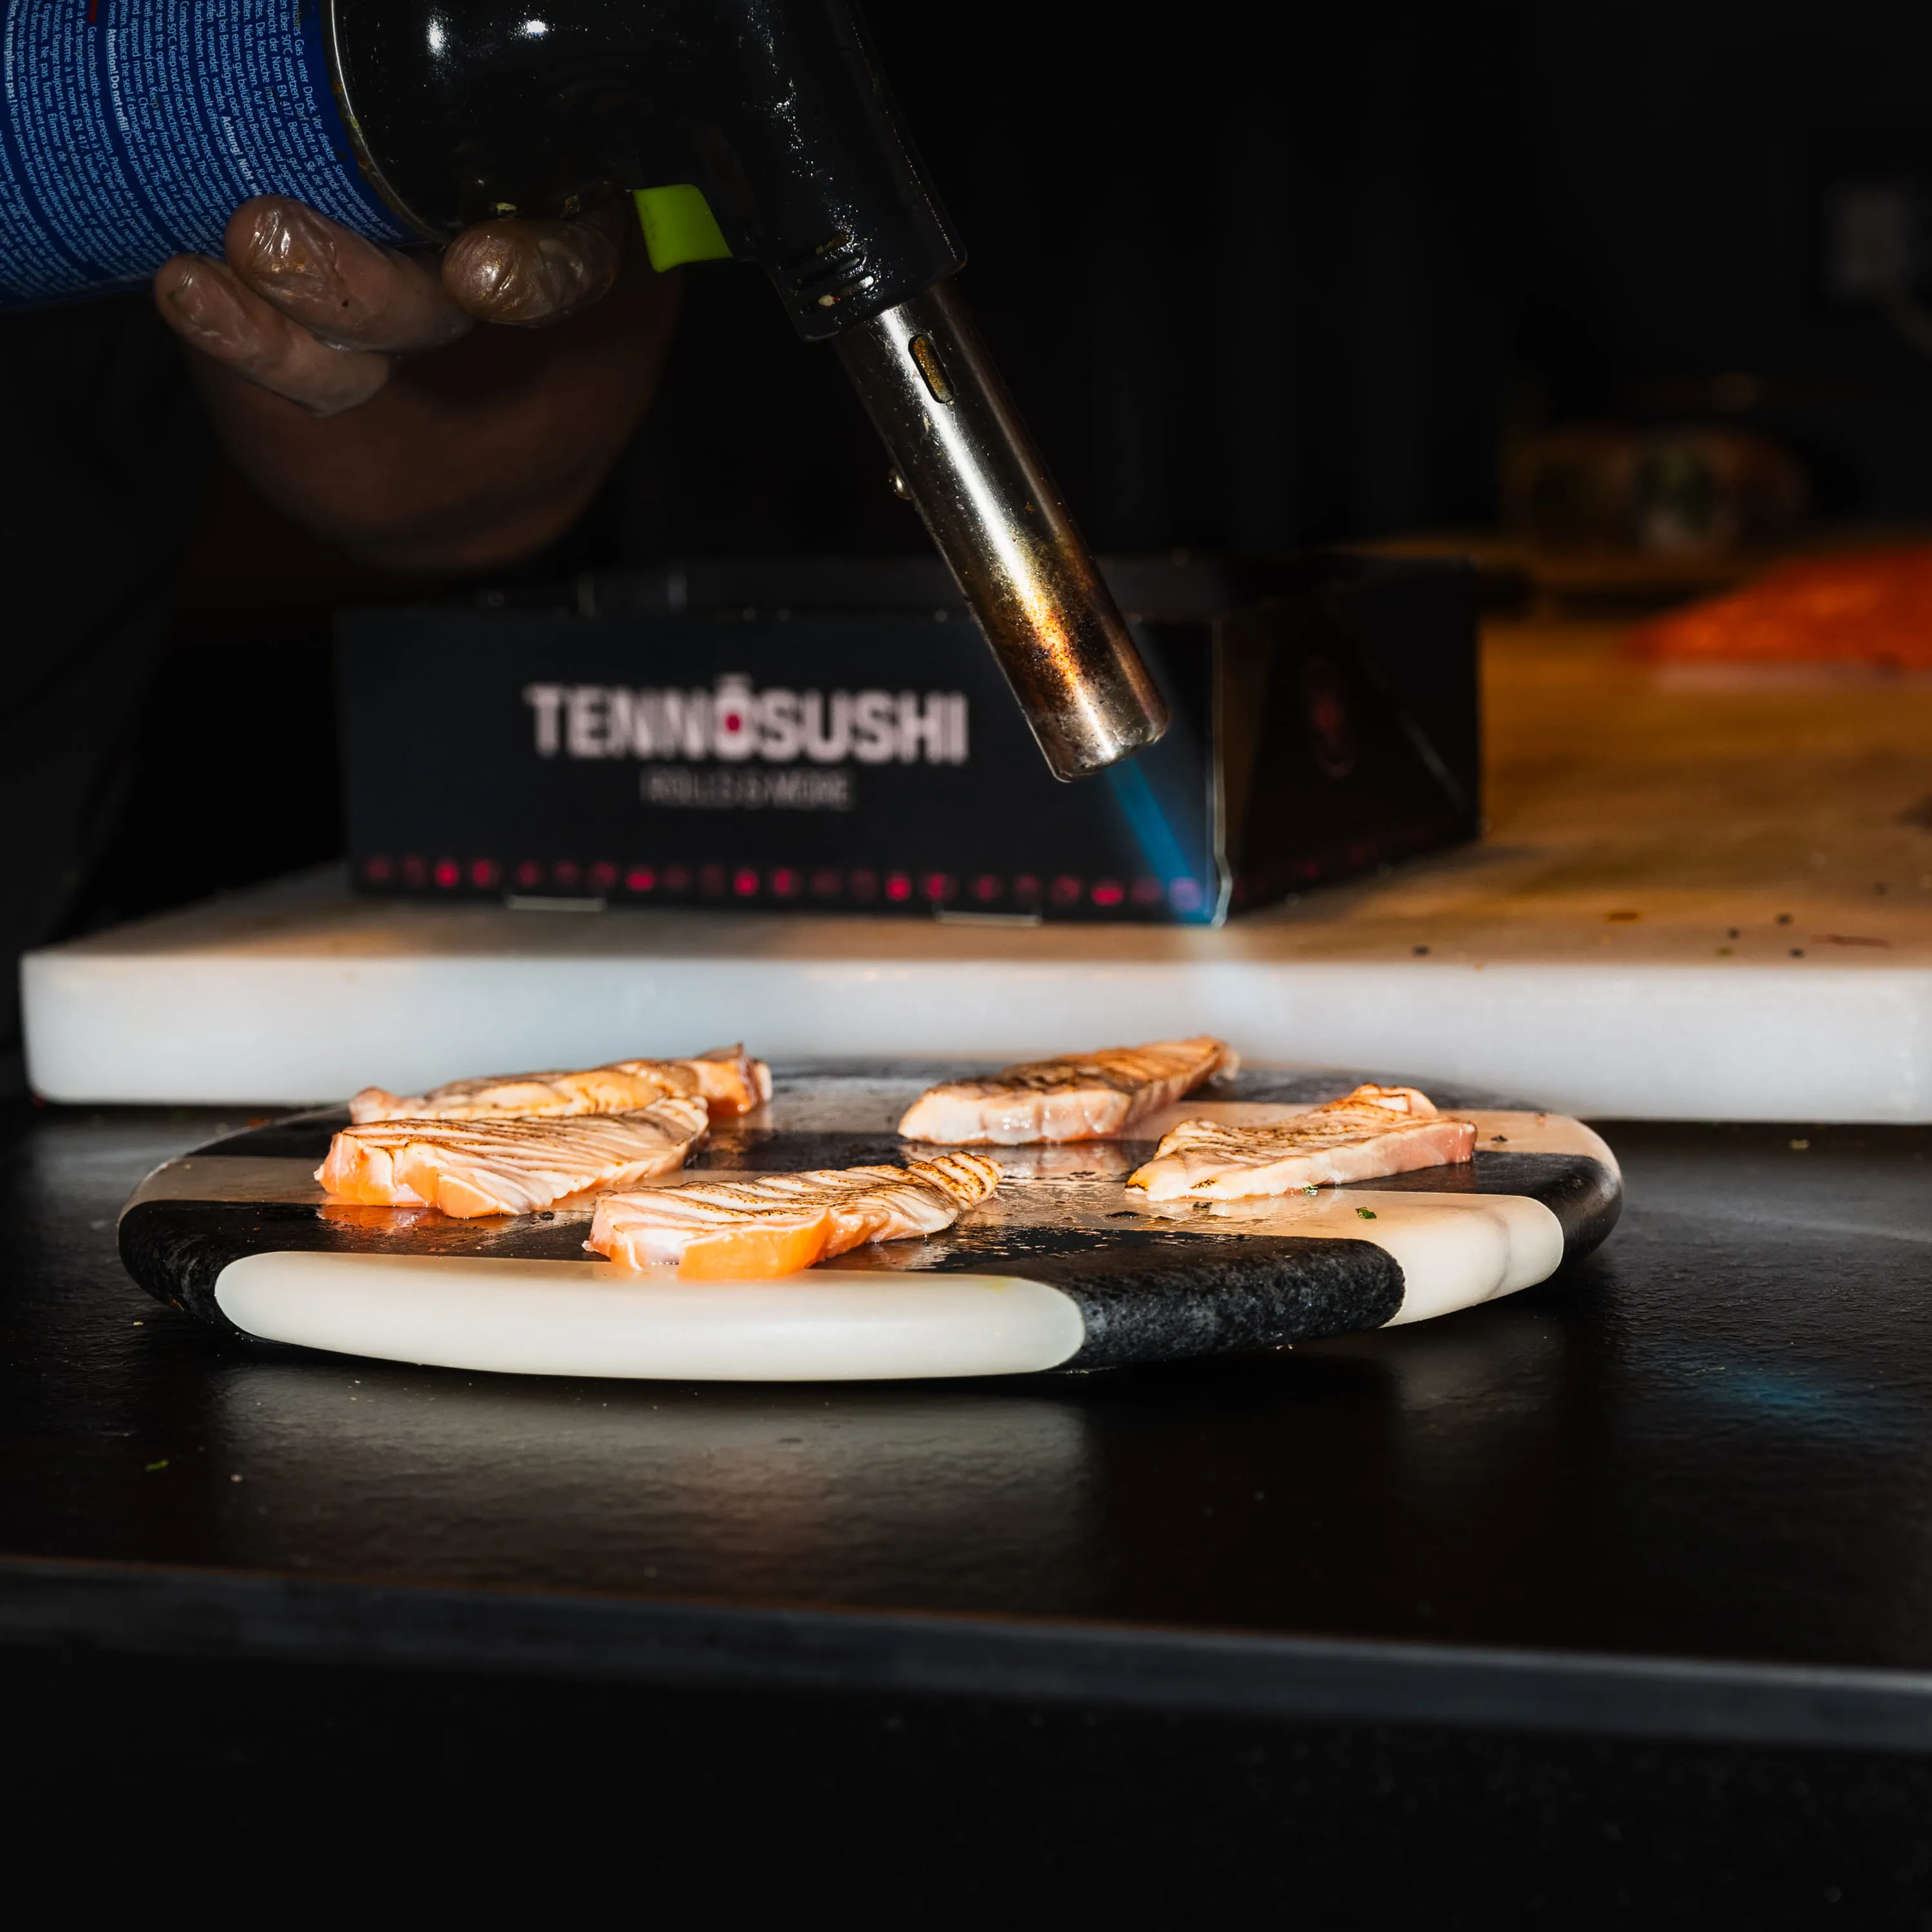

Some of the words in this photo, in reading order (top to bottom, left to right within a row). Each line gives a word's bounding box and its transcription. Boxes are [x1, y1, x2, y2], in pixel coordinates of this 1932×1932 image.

[30, 12, 40, 32] dans
[53, 3, 62, 33] associé.
[65, 7, 73, 20] est
[76, 18, 86, 33] des
[108, 2, 117, 27] ovens.
[280, 12, 290, 32] über
[88, 26, 97, 43] Gaz
[129, 17, 141, 57] approved
[144, 1, 153, 60] well-ventilated
[167, 23, 177, 45] 50°C.
[179, 1, 189, 53] Combustible
[194, 1, 204, 61] durchstechen,
[218, 19, 228, 33] bei
[244, 24, 254, 48] Nicht
[256, 22, 265, 37] Die
[50, 33, 61, 65] Rangez
[64, 23, 73, 62] conforme
[108, 28, 118, 74] Attention!
[118, 28, 129, 61] Replace
[156, 33, 165, 48] the
[232, 33, 241, 61] einem
[269, 37, 279, 52] der
[281, 34, 292, 55] 50°C
[294, 39, 304, 56] Gas
[4, 33, 14, 81] remplissez
[17, 51, 25, 75] perte.
[29, 44, 38, 75] endroit
[75, 35, 86, 91] températures
[168, 45, 177, 67] Keep
[179, 54, 189, 70] gas
[220, 34, 234, 95] Beschädigung
[258, 40, 270, 83] Kartusche
[39, 62, 48, 78] pas
[88, 44, 100, 97] combustible
[121, 62, 130, 77] the
[133, 60, 144, 95] manner.
[144, 61, 155, 86] place.
[155, 51, 168, 92] operating
[170, 68, 180, 83] out
[197, 61, 207, 76] mit
[232, 63, 245, 78] gut
[246, 50, 258, 88] rauchen.
[272, 56, 282, 81] Norm
[284, 57, 299, 101] aussetzen.
[298, 59, 308, 83] unter
[5, 82, 15, 99] pas
[18, 76, 28, 99] Cette
[30, 75, 39, 95] bien
[43, 82, 53, 109] fumer.
[52, 66, 63, 101] toujours
[123, 79, 134, 95] seal
[183, 71, 194, 96] under
[200, 77, 213, 107] Gewalt
[32, 97, 44, 115] aéré
[68, 87, 78, 115] norme
[93, 99, 103, 118] sous
[112, 90, 122, 106] not
[149, 86, 159, 108] Keep
[175, 93, 187, 117] reach
[207, 26, 218, 73] verwendet
[213, 77, 225, 112] werden.
[222, 116, 243, 155] Achtung!
[238, 159, 254, 180] Nicht
[229, 97, 240, 116] oder
[238, 79, 254, 122] belüfteten
[252, 90, 265, 105] Auf
[265, 86, 278, 114] immer
[303, 86, 317, 113] Druck.
[21, 99, 35, 142] cartouche
[80, 93, 97, 141] supérieures
[116, 107, 129, 131] refill!
[138, 97, 152, 129] Change
[153, 109, 165, 130] away
[163, 95, 181, 142] instructions
[186, 97, 203, 134] pressure.
[207, 108, 220, 135] öffnen
[281, 100, 294, 119] 417.
[294, 102, 309, 120] Darf
[10, 118, 21, 133] pas
[48, 113, 61, 147] Éliminer
[59, 111, 75, 152] cartouche
[128, 104, 146, 142] damaged
[258, 108, 275, 144] sicherem
[301, 123, 316, 144] nicht
[312, 115, 323, 129] Vor
[14, 134, 29, 161] percer,
[38, 126, 48, 145] sans
[78, 134, 90, 152] 417.
[96, 119, 113, 155] pression.
[147, 132, 157, 146] the
[160, 131, 171, 151] from
[184, 126, 200, 160] children.
[216, 137, 228, 155] oder
[250, 124, 267, 153] Bereich
[278, 130, 293, 155] einem
[288, 122, 307, 158] Beachten
[319, 133, 336, 162] direkter
[43, 146, 57, 172] source
[126, 145, 138, 159] not
[176, 144, 186, 155] for
[199, 134, 215, 162] Protect
[271, 146, 285, 162] und
[24, 161, 38, 184] forcer
[34, 154, 46, 171] doit
[71, 153, 82, 173] dans
[84, 154, 100, 184] Veuillez
[109, 156, 128, 189] Protéger
[142, 155, 155, 171] lost.
[153, 148, 172, 182] cartridge
[167, 152, 184, 180] sources
[182, 156, 193, 171] the
[196, 160, 208, 175] This
[210, 162, 223, 180] from
[261, 153, 276, 173] ohne
[287, 157, 301, 171] gut
[304, 161, 316, 172] Sie
[314, 155, 325, 166] die
[40, 171, 51, 187] être
[63, 166, 80, 196] manière
[103, 171, 116, 189] Tenir
[149, 171, 161, 186] This
[224, 156, 249, 198] verbrennen.
[312, 175, 323, 185] die
[322, 167, 339, 190] Hände
[83, 184, 102, 211] endroit
[112, 191, 125, 207] hors
[144, 185, 157, 203] force
[157, 187, 179, 216] cartridge
[188, 172, 214, 207] associated
[204, 175, 225, 205] cartridge
[219, 181, 236, 200] direct
[298, 173, 329, 213] durchlüfteten
[336, 191, 349, 203] von
[97, 186, 118, 218] respecter
[153, 203, 168, 220] open
[183, 189, 204, 216] ignition.
[97, 211, 110, 225] bien
